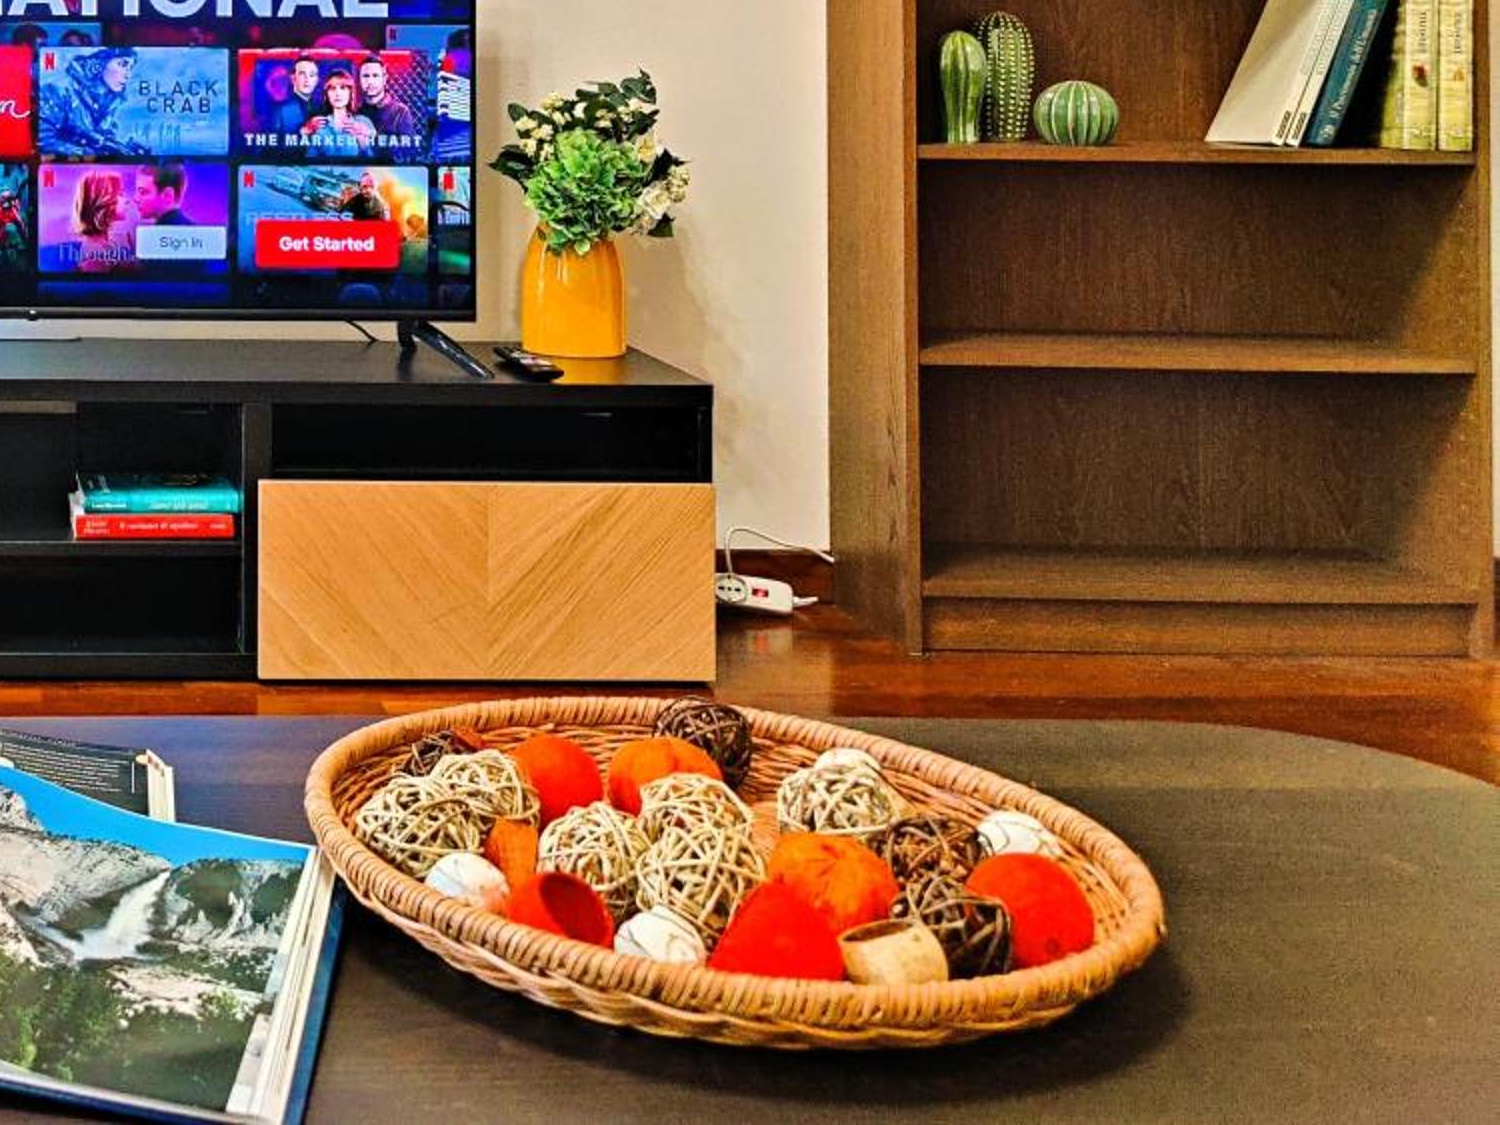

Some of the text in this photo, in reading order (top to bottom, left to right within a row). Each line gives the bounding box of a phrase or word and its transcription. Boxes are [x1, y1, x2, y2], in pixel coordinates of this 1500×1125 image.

[138, 79, 219, 97] BLACK
[146, 96, 212, 114] CRAB
[244, 132, 424, 148] THE MARKED HEART
[159, 236, 204, 252] Sign In
[278, 235, 376, 252] Get Started
